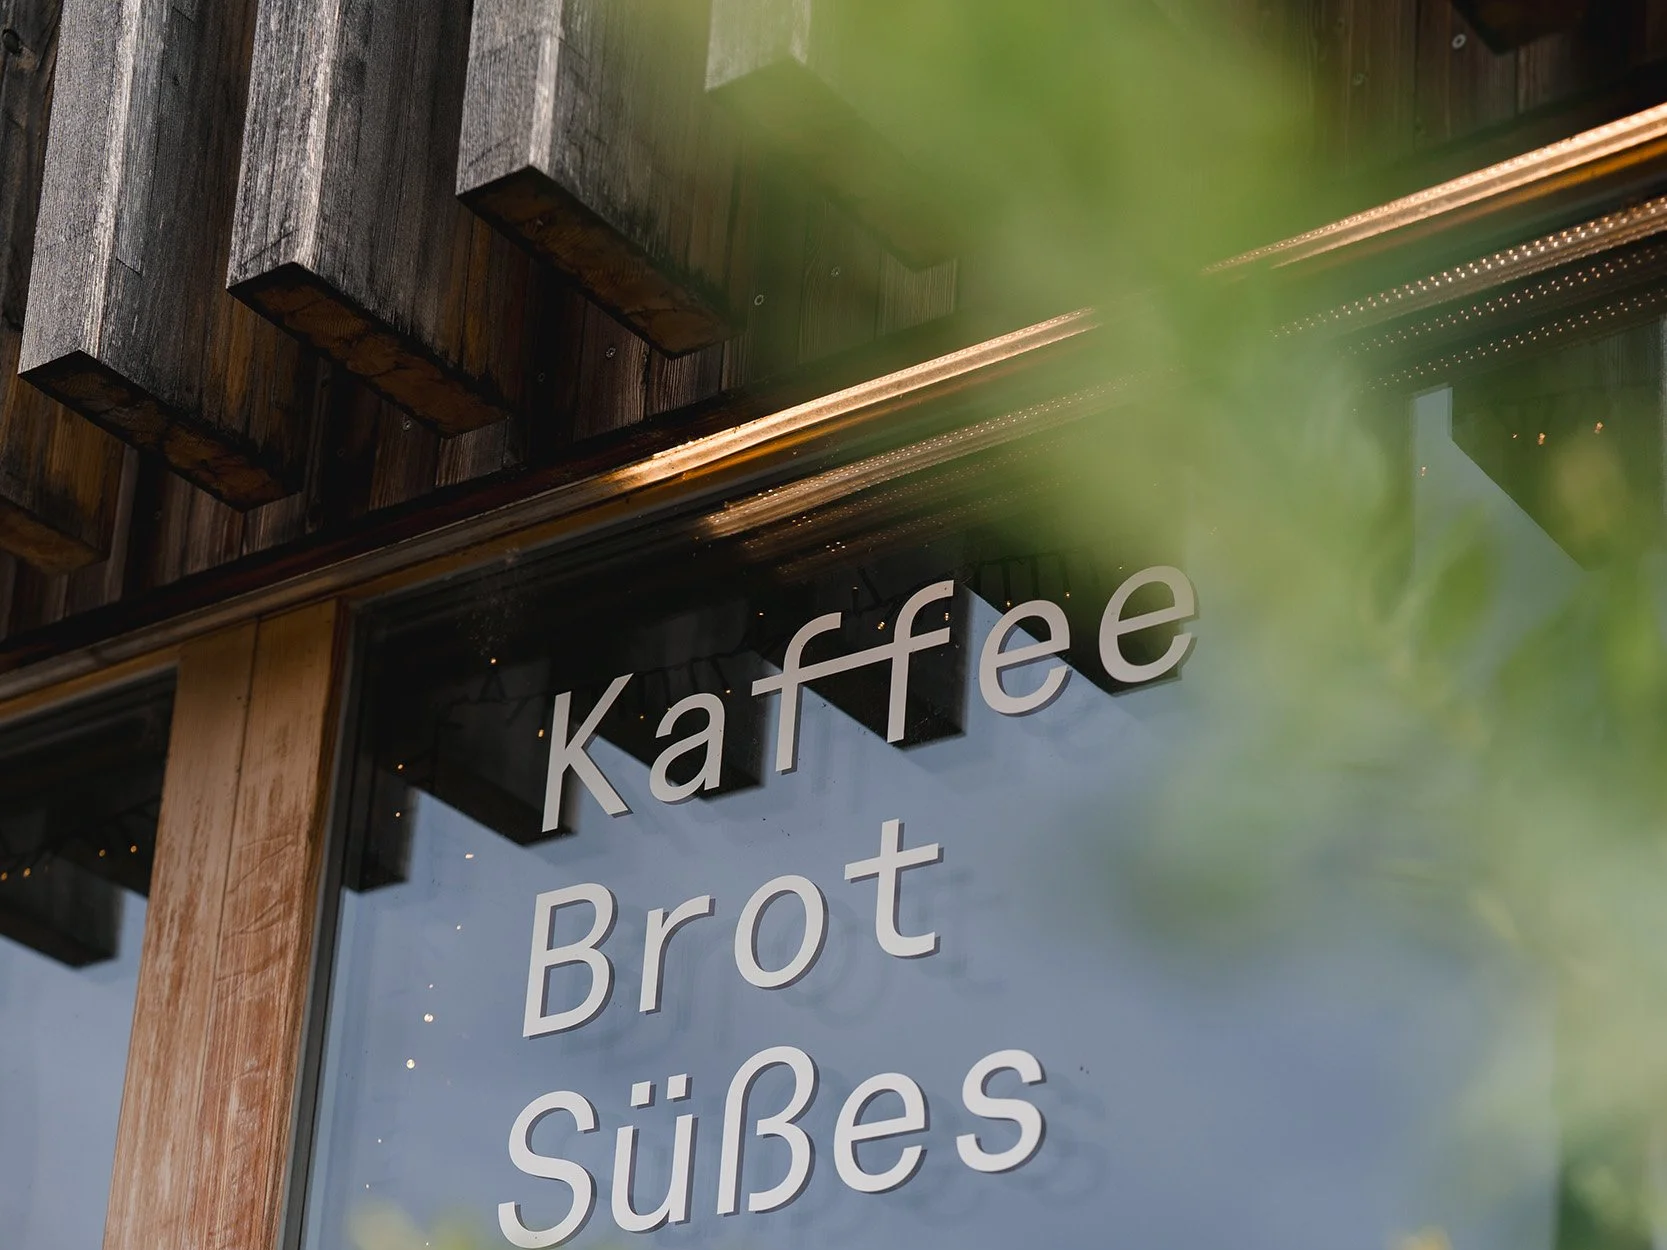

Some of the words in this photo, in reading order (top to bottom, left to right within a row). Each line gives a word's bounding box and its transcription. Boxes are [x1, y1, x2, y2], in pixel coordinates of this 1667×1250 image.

[542, 565, 1198, 832] Kaffee
[522, 819, 941, 1038] Brot
[498, 1045, 1044, 1249] Süßes
